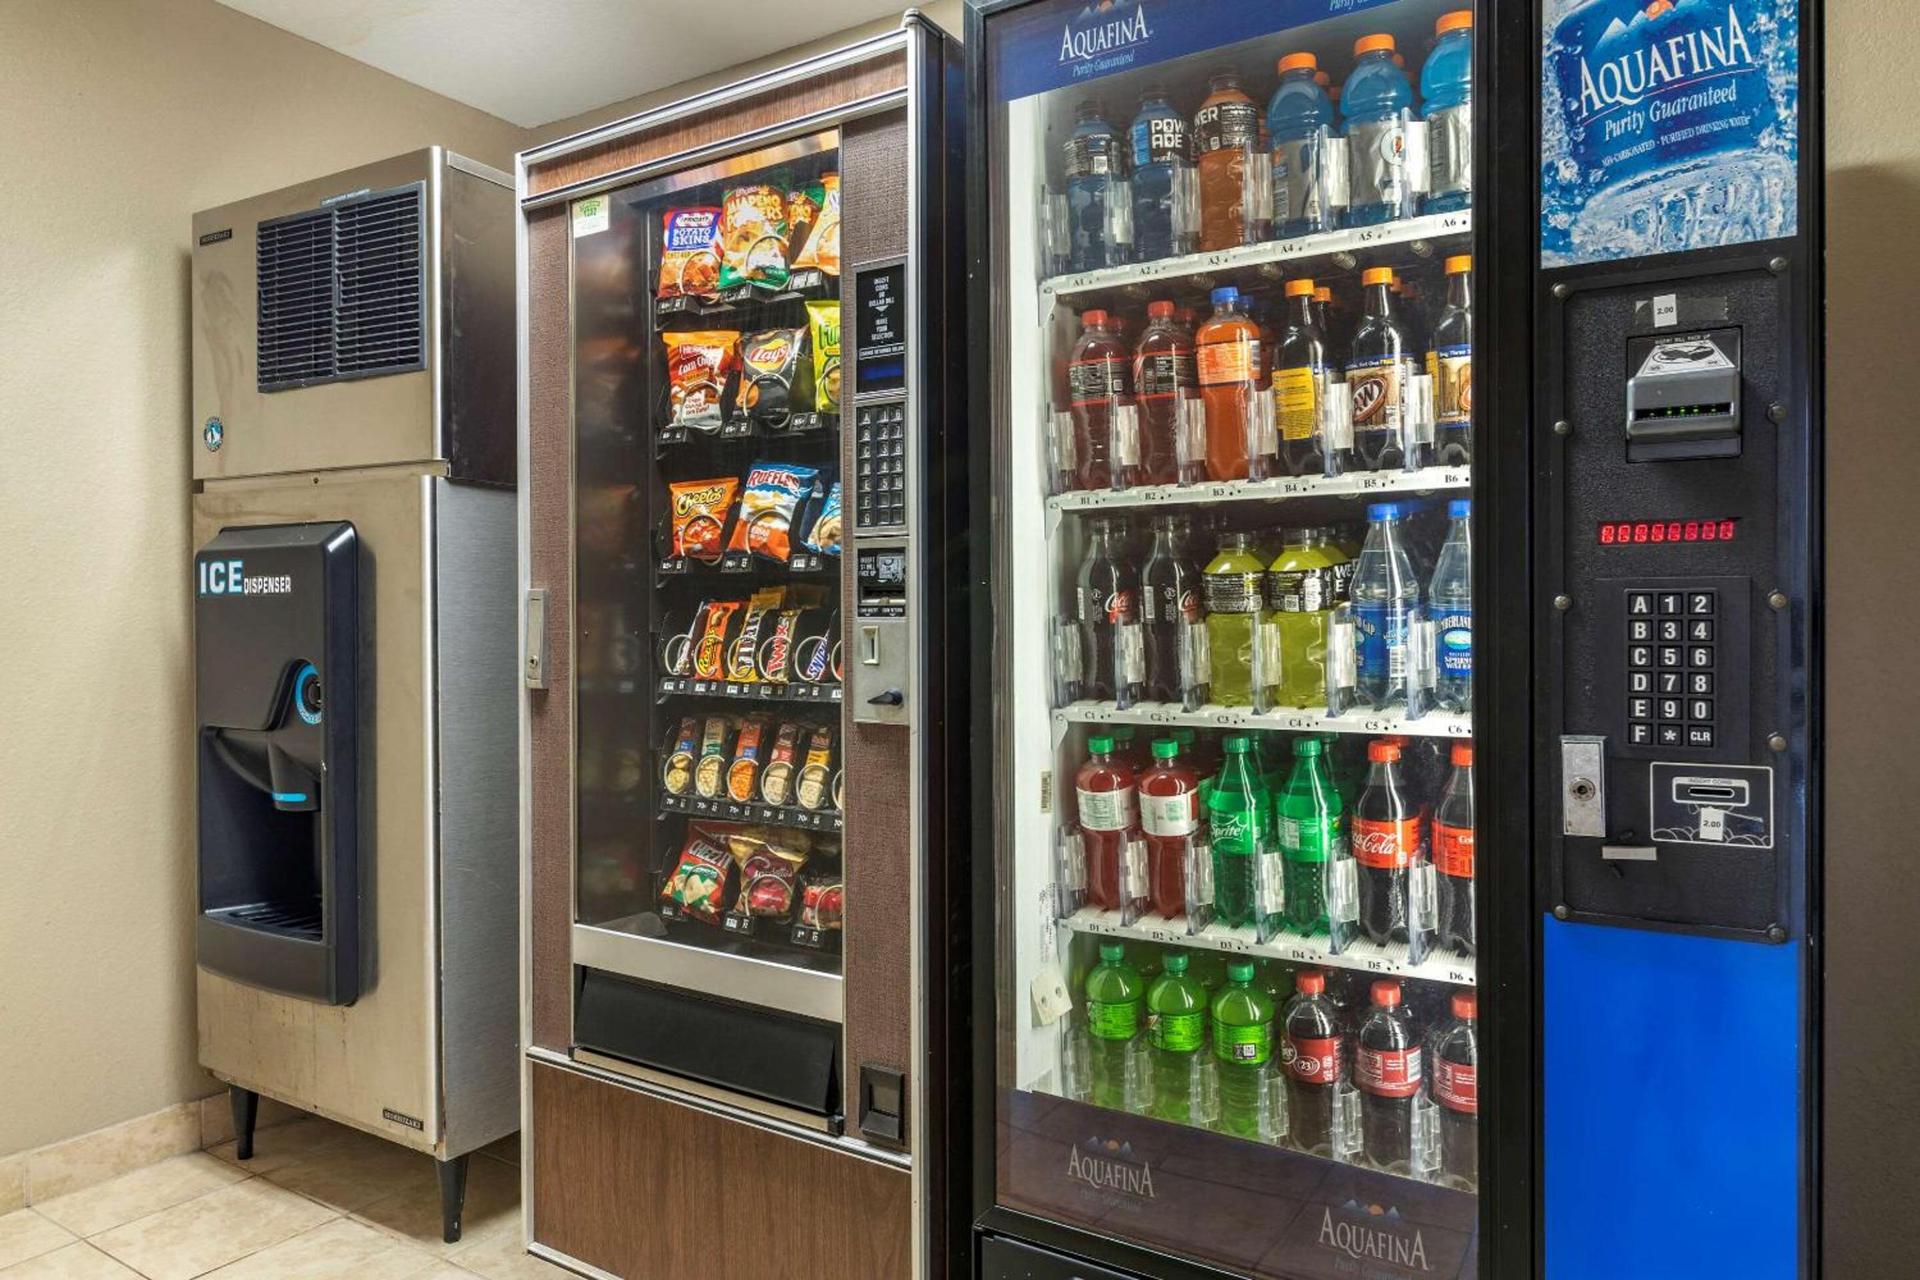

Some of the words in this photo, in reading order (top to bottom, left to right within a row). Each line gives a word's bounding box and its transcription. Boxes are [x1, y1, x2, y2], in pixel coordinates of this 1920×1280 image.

[1059, 3, 1150, 61] AQUAFINA
[1580, 4, 1753, 118] AQUAFINA
[1605, 110, 1646, 141] Purity
[1649, 79, 1737, 123] Guaranteed
[1151, 134, 1182, 148] ADE
[1442, 218, 1456, 229] A6
[672, 234, 710, 247] SKINS
[1359, 231, 1373, 241] A5
[1281, 244, 1293, 253] A4
[1208, 255, 1220, 265] A3
[1139, 267, 1150, 275] A2
[1073, 278, 1084, 287] A1
[1657, 306, 1674, 314] 2.00
[679, 360, 696, 376] Corn
[746, 469, 801, 494] RUFFLES
[1364, 479, 1377, 488] B5
[1444, 474, 1458, 483] B6
[1213, 488, 1224, 496] B3
[1285, 483, 1297, 492] B4
[676, 487, 725, 516] Cheetos
[1081, 496, 1090, 505] B1
[1145, 491, 1156, 500] B2
[200, 561, 243, 594] ICE
[244, 576, 292, 595] DISPENSER
[1633, 596, 1647, 613] A
[1664, 596, 1674, 613] 1
[1694, 596, 1706, 613] 2
[1634, 622, 1646, 639] B
[1664, 622, 1676, 639] 3
[1694, 622, 1707, 639] 4
[1634, 648, 1646, 665] C
[1664, 648, 1676, 665] 5
[1695, 648, 1707, 666] 6
[1634, 674, 1646, 691] D
[1664, 675, 1676, 691] 7
[1695, 675, 1707, 692] 8
[1635, 700, 1646, 717] E
[1664, 700, 1676, 718] 9
[1694, 701, 1706, 719] 0
[1150, 713, 1162, 721] C2
[1217, 716, 1229, 724] C3
[1289, 719, 1302, 727] C4
[1365, 721, 1378, 730] C5
[1448, 725, 1462, 734] C6
[1635, 725, 1646, 742] F
[1690, 731, 1711, 741] CLR
[1211, 822, 1242, 838] Sprite
[1703, 820, 1721, 828] 2.00
[1152, 932, 1163, 940] D2
[1220, 941, 1232, 949] D3
[1292, 950, 1304, 959] D4
[1368, 961, 1381, 970] D5
[1449, 972, 1463, 981] D6
[1067, 1143, 1155, 1197] AQUAFINA
[1318, 1206, 1429, 1271] AQUAFINA
